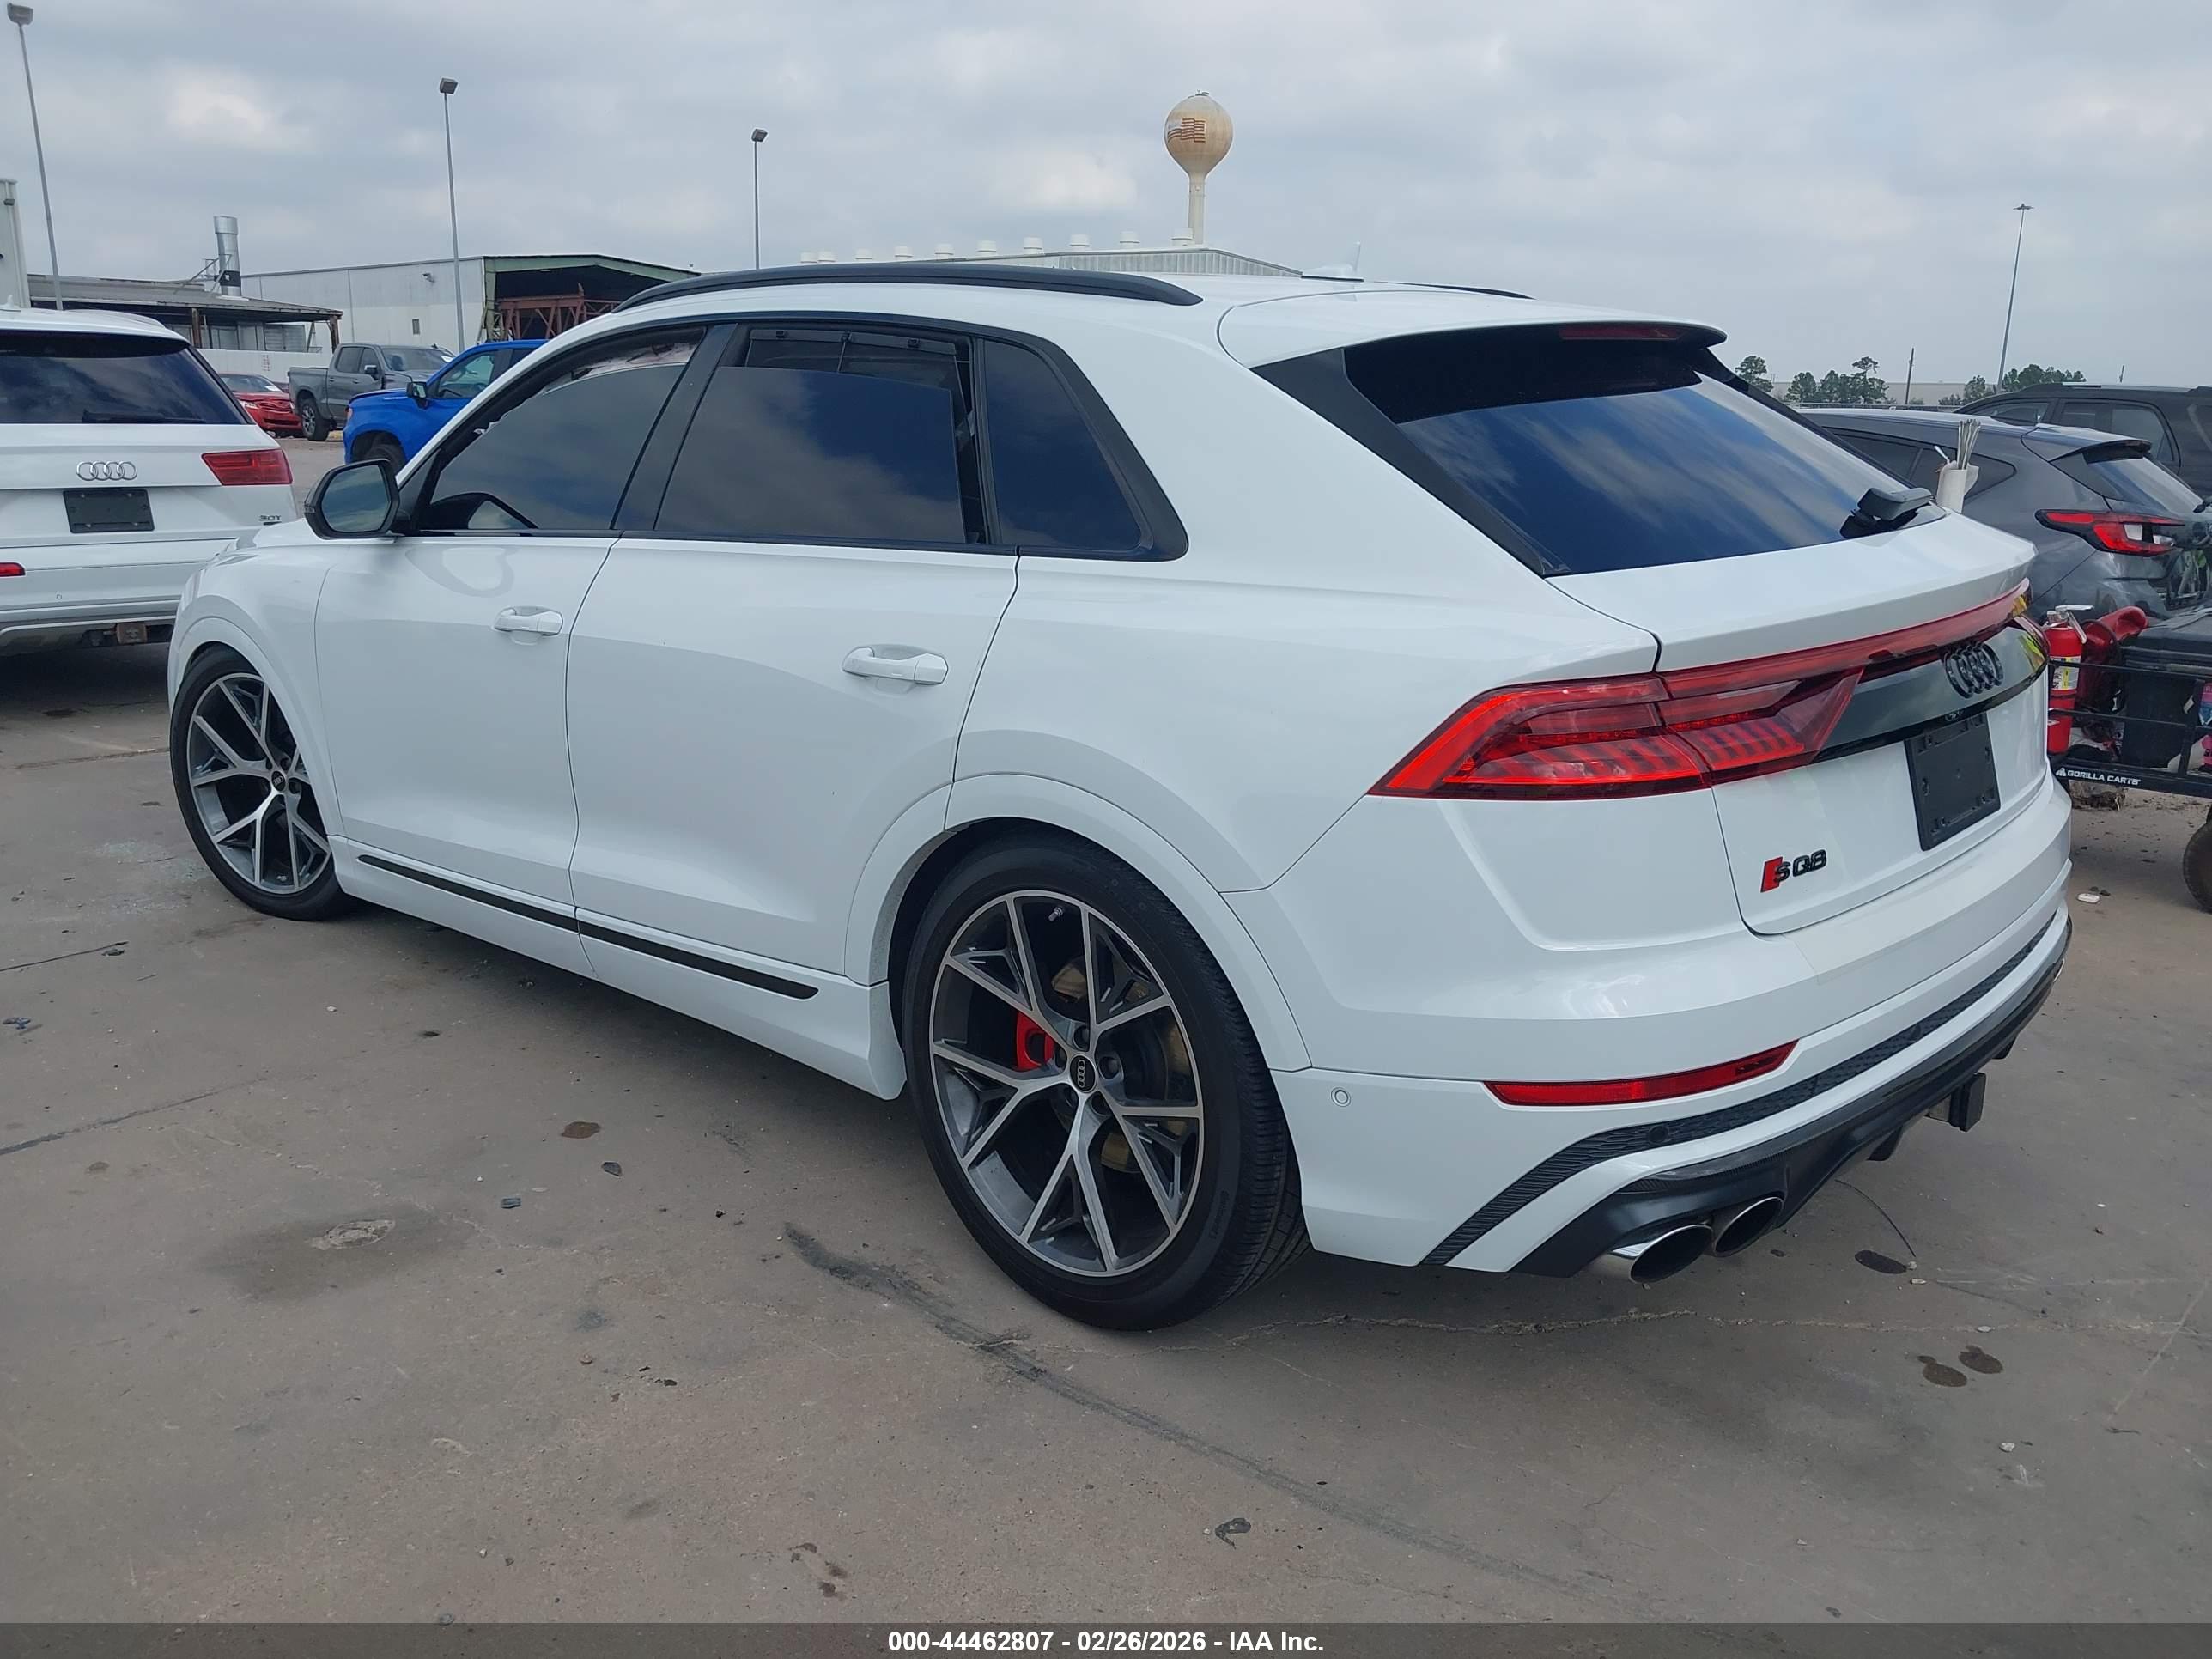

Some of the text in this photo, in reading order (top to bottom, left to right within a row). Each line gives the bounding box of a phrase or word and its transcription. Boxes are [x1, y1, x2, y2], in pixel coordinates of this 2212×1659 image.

[2067, 769, 2141, 786] GORILLA CARTS
[1772, 848, 1827, 884] SQ8
